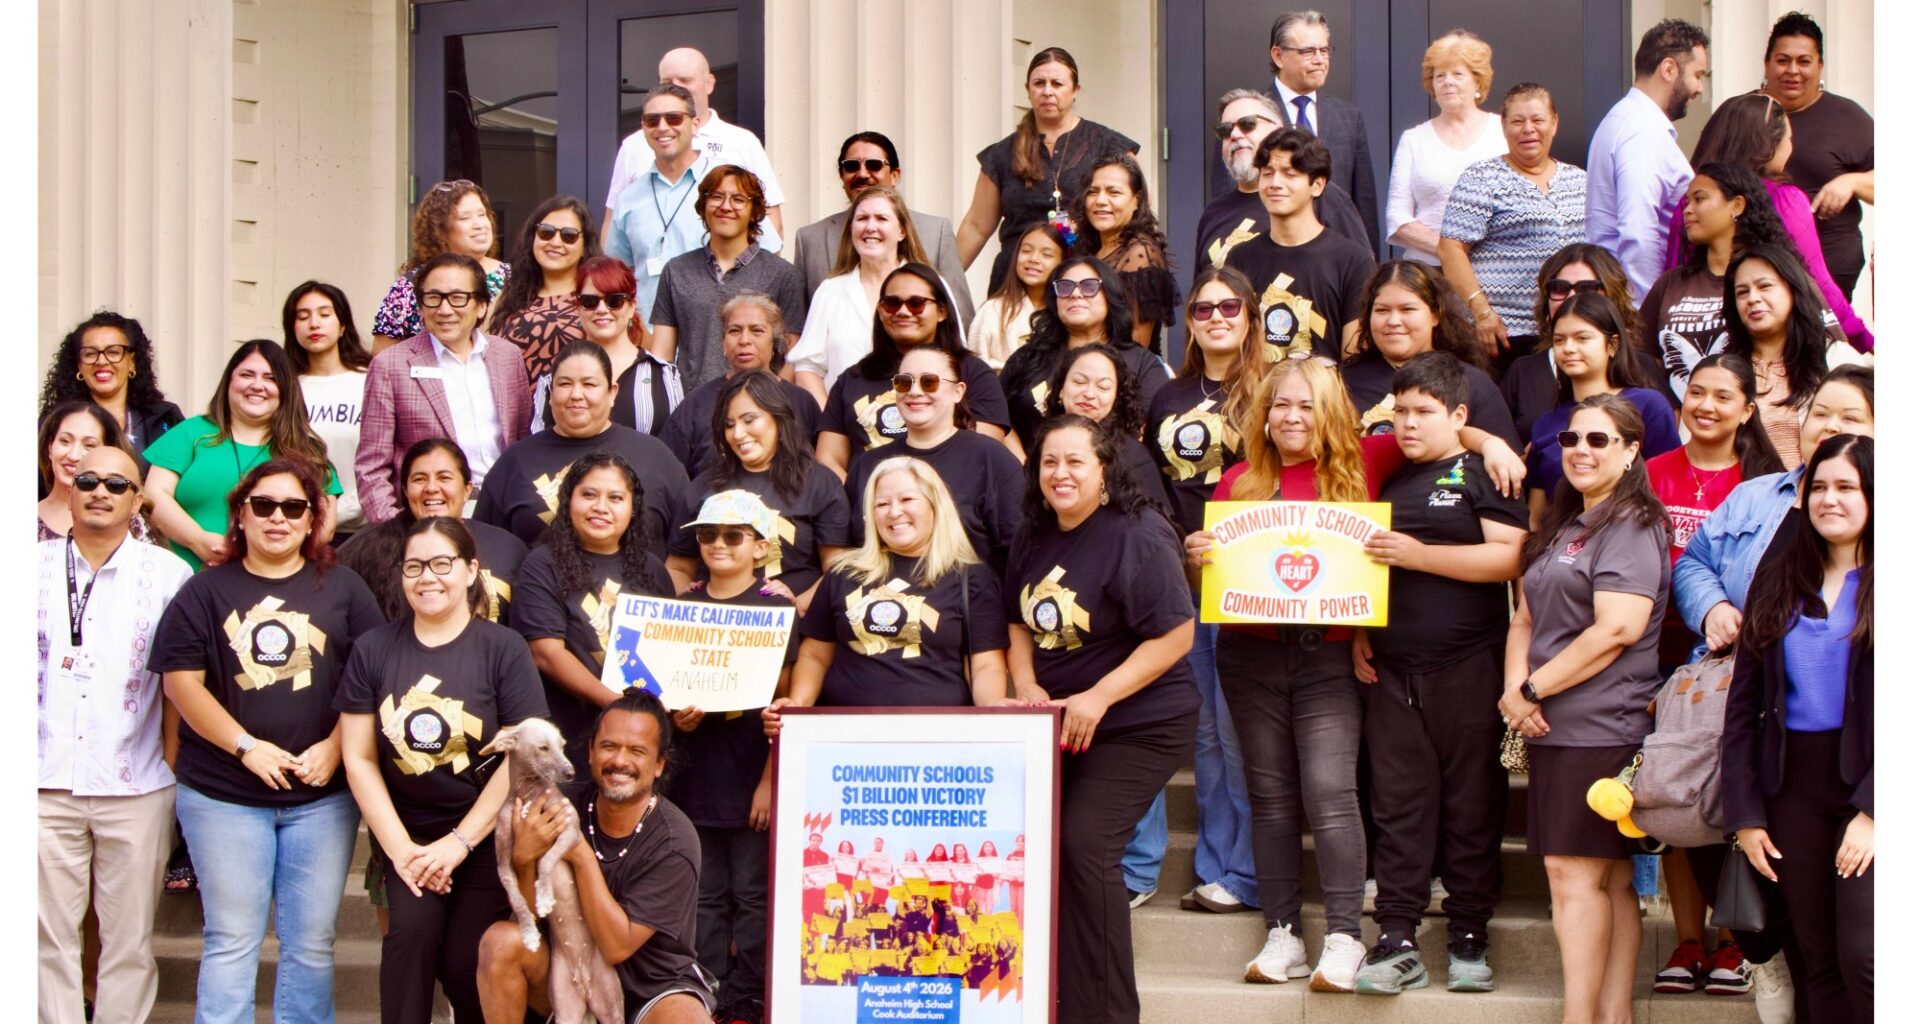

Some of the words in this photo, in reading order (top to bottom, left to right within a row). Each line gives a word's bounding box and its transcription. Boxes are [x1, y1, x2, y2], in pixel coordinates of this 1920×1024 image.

[1215, 505, 1307, 545] COMMUNITY
[1315, 507, 1383, 543] SCHOOL
[1280, 565, 1313, 580] HEART
[625, 598, 660, 619] LET'S
[661, 603, 698, 623] MAKE
[701, 606, 773, 628] CALIFORNIA
[776, 611, 785, 627] A
[1223, 591, 1307, 619] COMMUNITY
[1320, 595, 1369, 619] POWER
[643, 622, 725, 646] COMMUNITY
[727, 628, 787, 648] SCHOOLS
[869, 624, 897, 633] OCCCO
[257, 653, 287, 661] OCCCO
[691, 649, 732, 668] STATE
[669, 670, 739, 692] ANAHEIM
[832, 765, 920, 783] COMMUNITY
[923, 765, 994, 783] SCHOOLS
[842, 785, 859, 805] $1
[862, 787, 918, 805] BILLION
[921, 787, 986, 805] VICTORY
[840, 808, 889, 826] PRESS
[892, 809, 987, 828] CONFERENCE
[861, 981, 901, 996] August
[902, 981, 918, 993] 4th
[920, 982, 953, 995] 2026
[864, 998, 902, 1008] Anaheim
[904, 999, 924, 1011] High
[925, 999, 953, 1009] School
[872, 1009, 896, 1018] Cook
[896, 1010, 944, 1020] Auditorium
